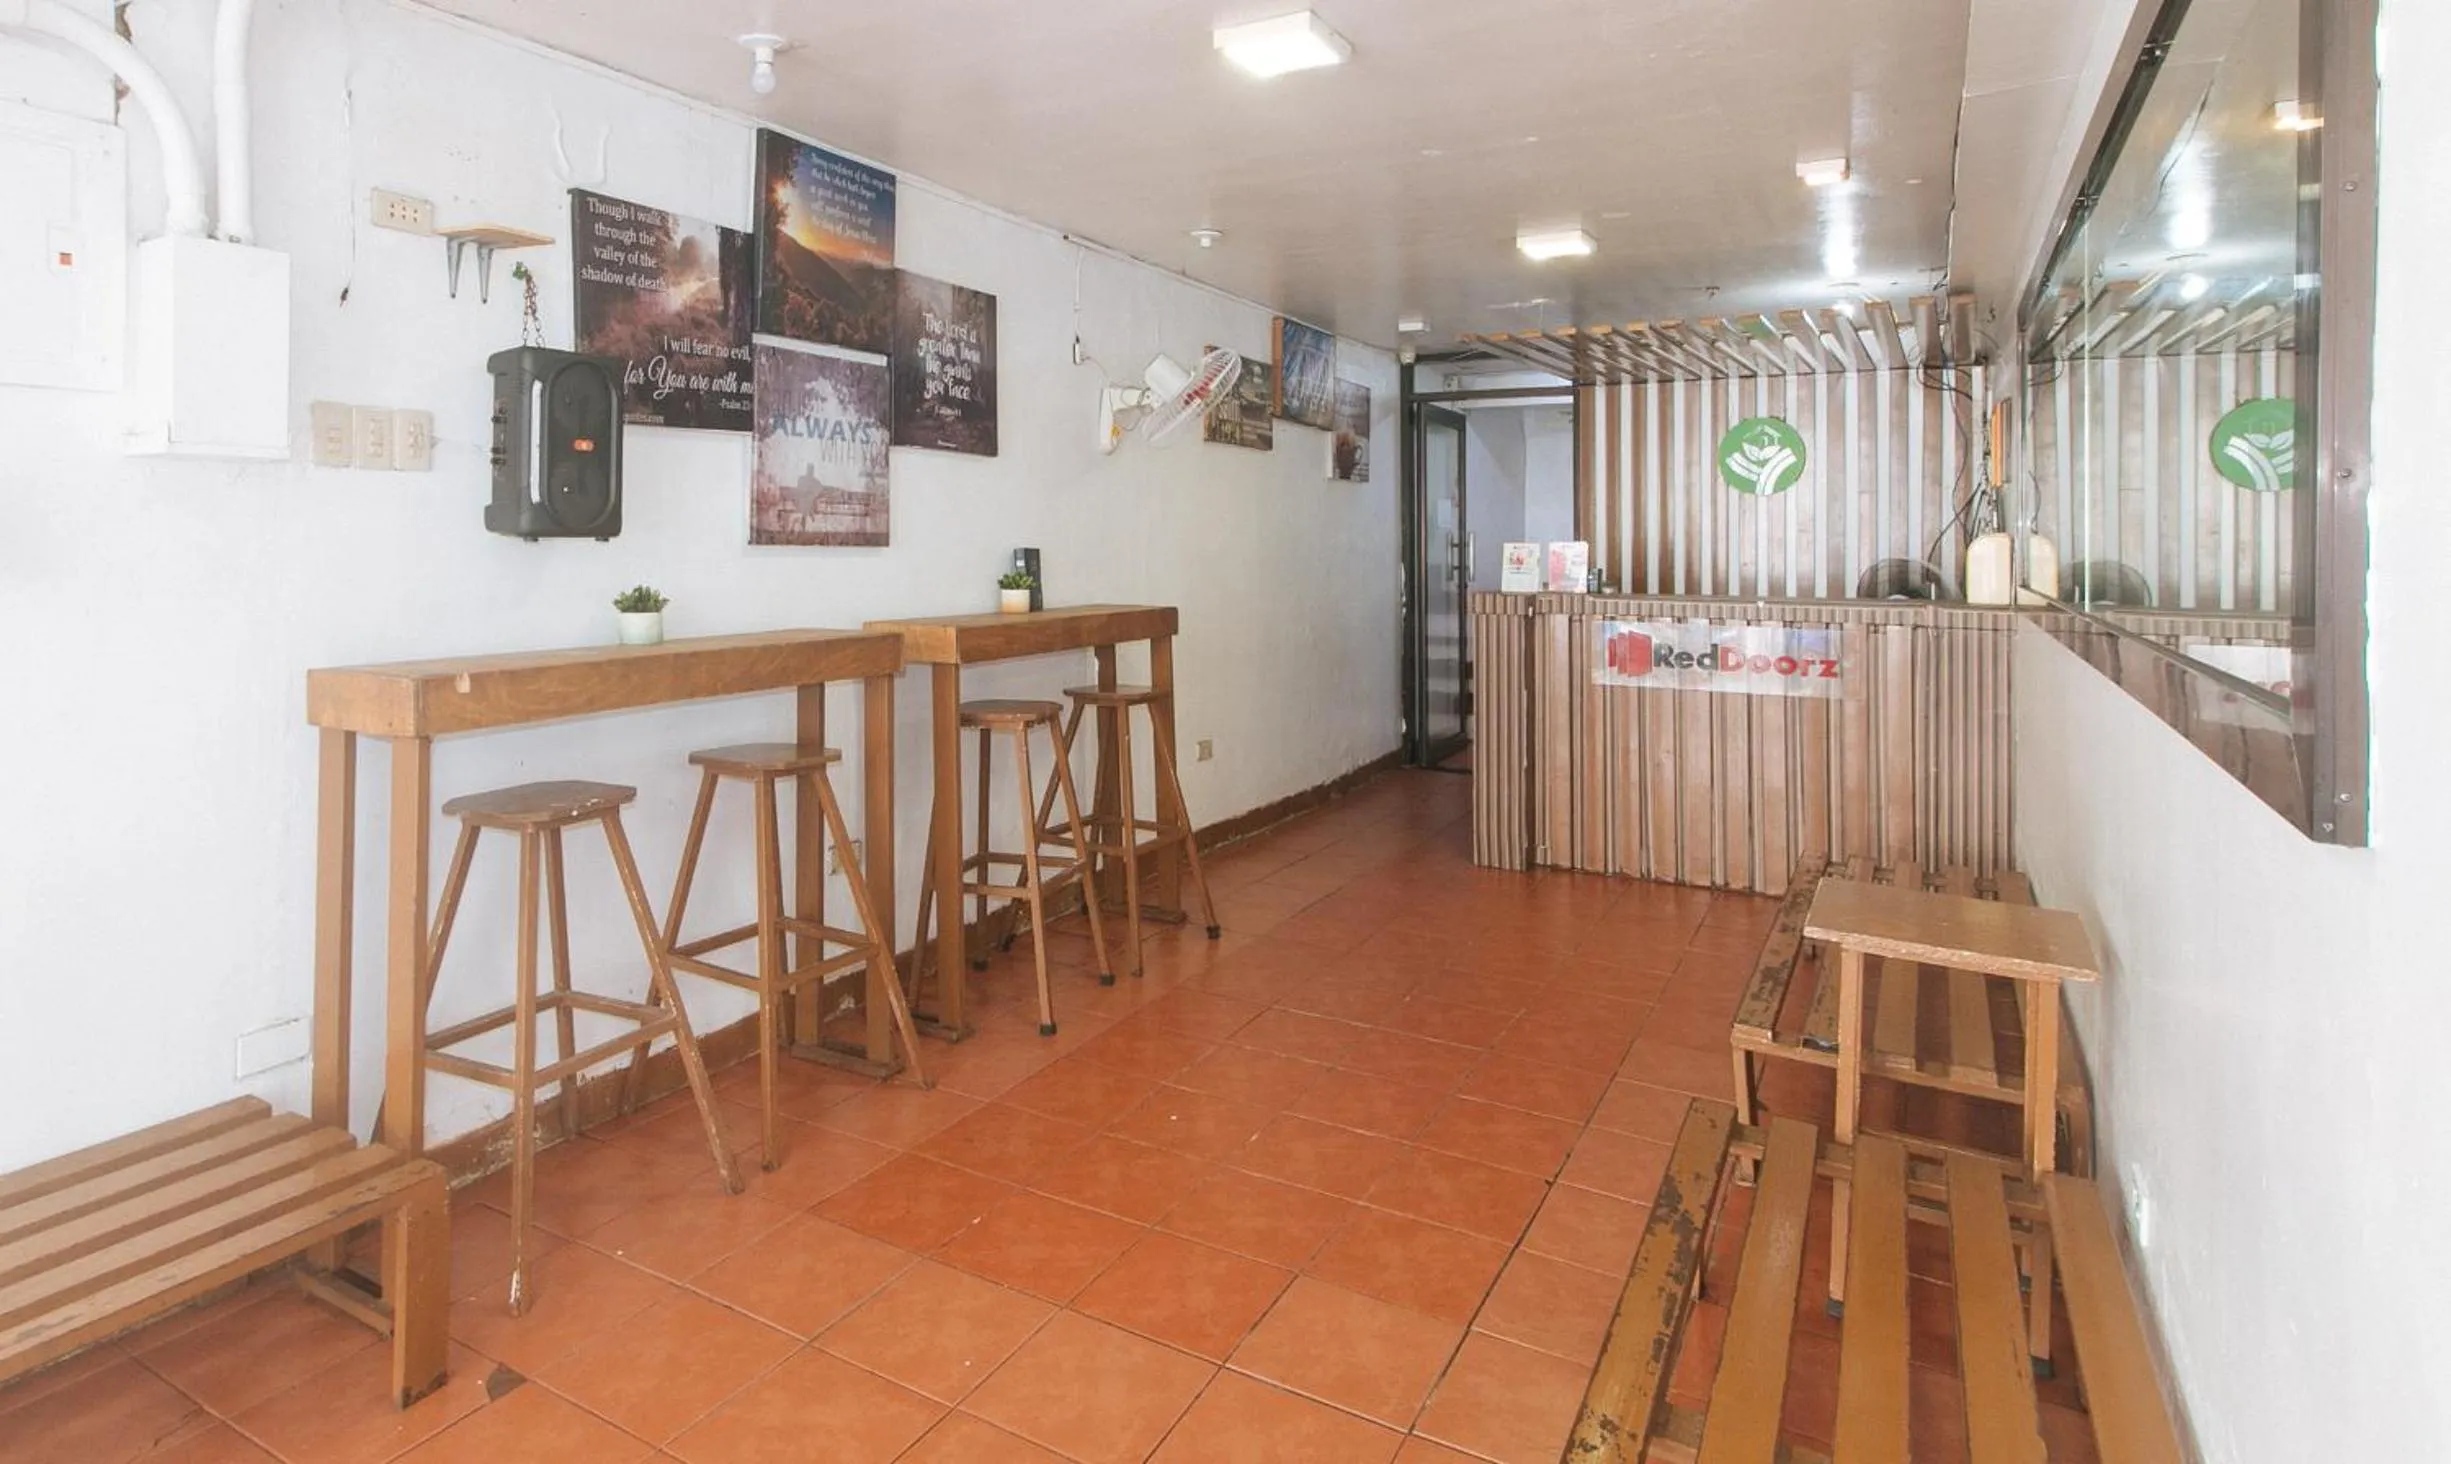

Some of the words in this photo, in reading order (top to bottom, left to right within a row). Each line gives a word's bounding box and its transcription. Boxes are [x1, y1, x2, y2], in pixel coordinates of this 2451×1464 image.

[587, 197, 628, 221] Though
[630, 206, 635, 220] I
[594, 221, 636, 246] through
[639, 229, 656, 246] the
[594, 245, 625, 266] valley
[627, 250, 639, 264] of
[640, 252, 659, 268] the
[581, 264, 624, 284] shadow
[625, 272, 637, 287] of
[664, 335, 668, 351] I
[670, 337, 691, 354] will
[692, 339, 713, 356] fear
[716, 346, 730, 358] no
[648, 355, 686, 400] You
[712, 371, 738, 393] with
[772, 412, 872, 445] ALWAYS
[1653, 642, 1839, 679] RedDoorz
